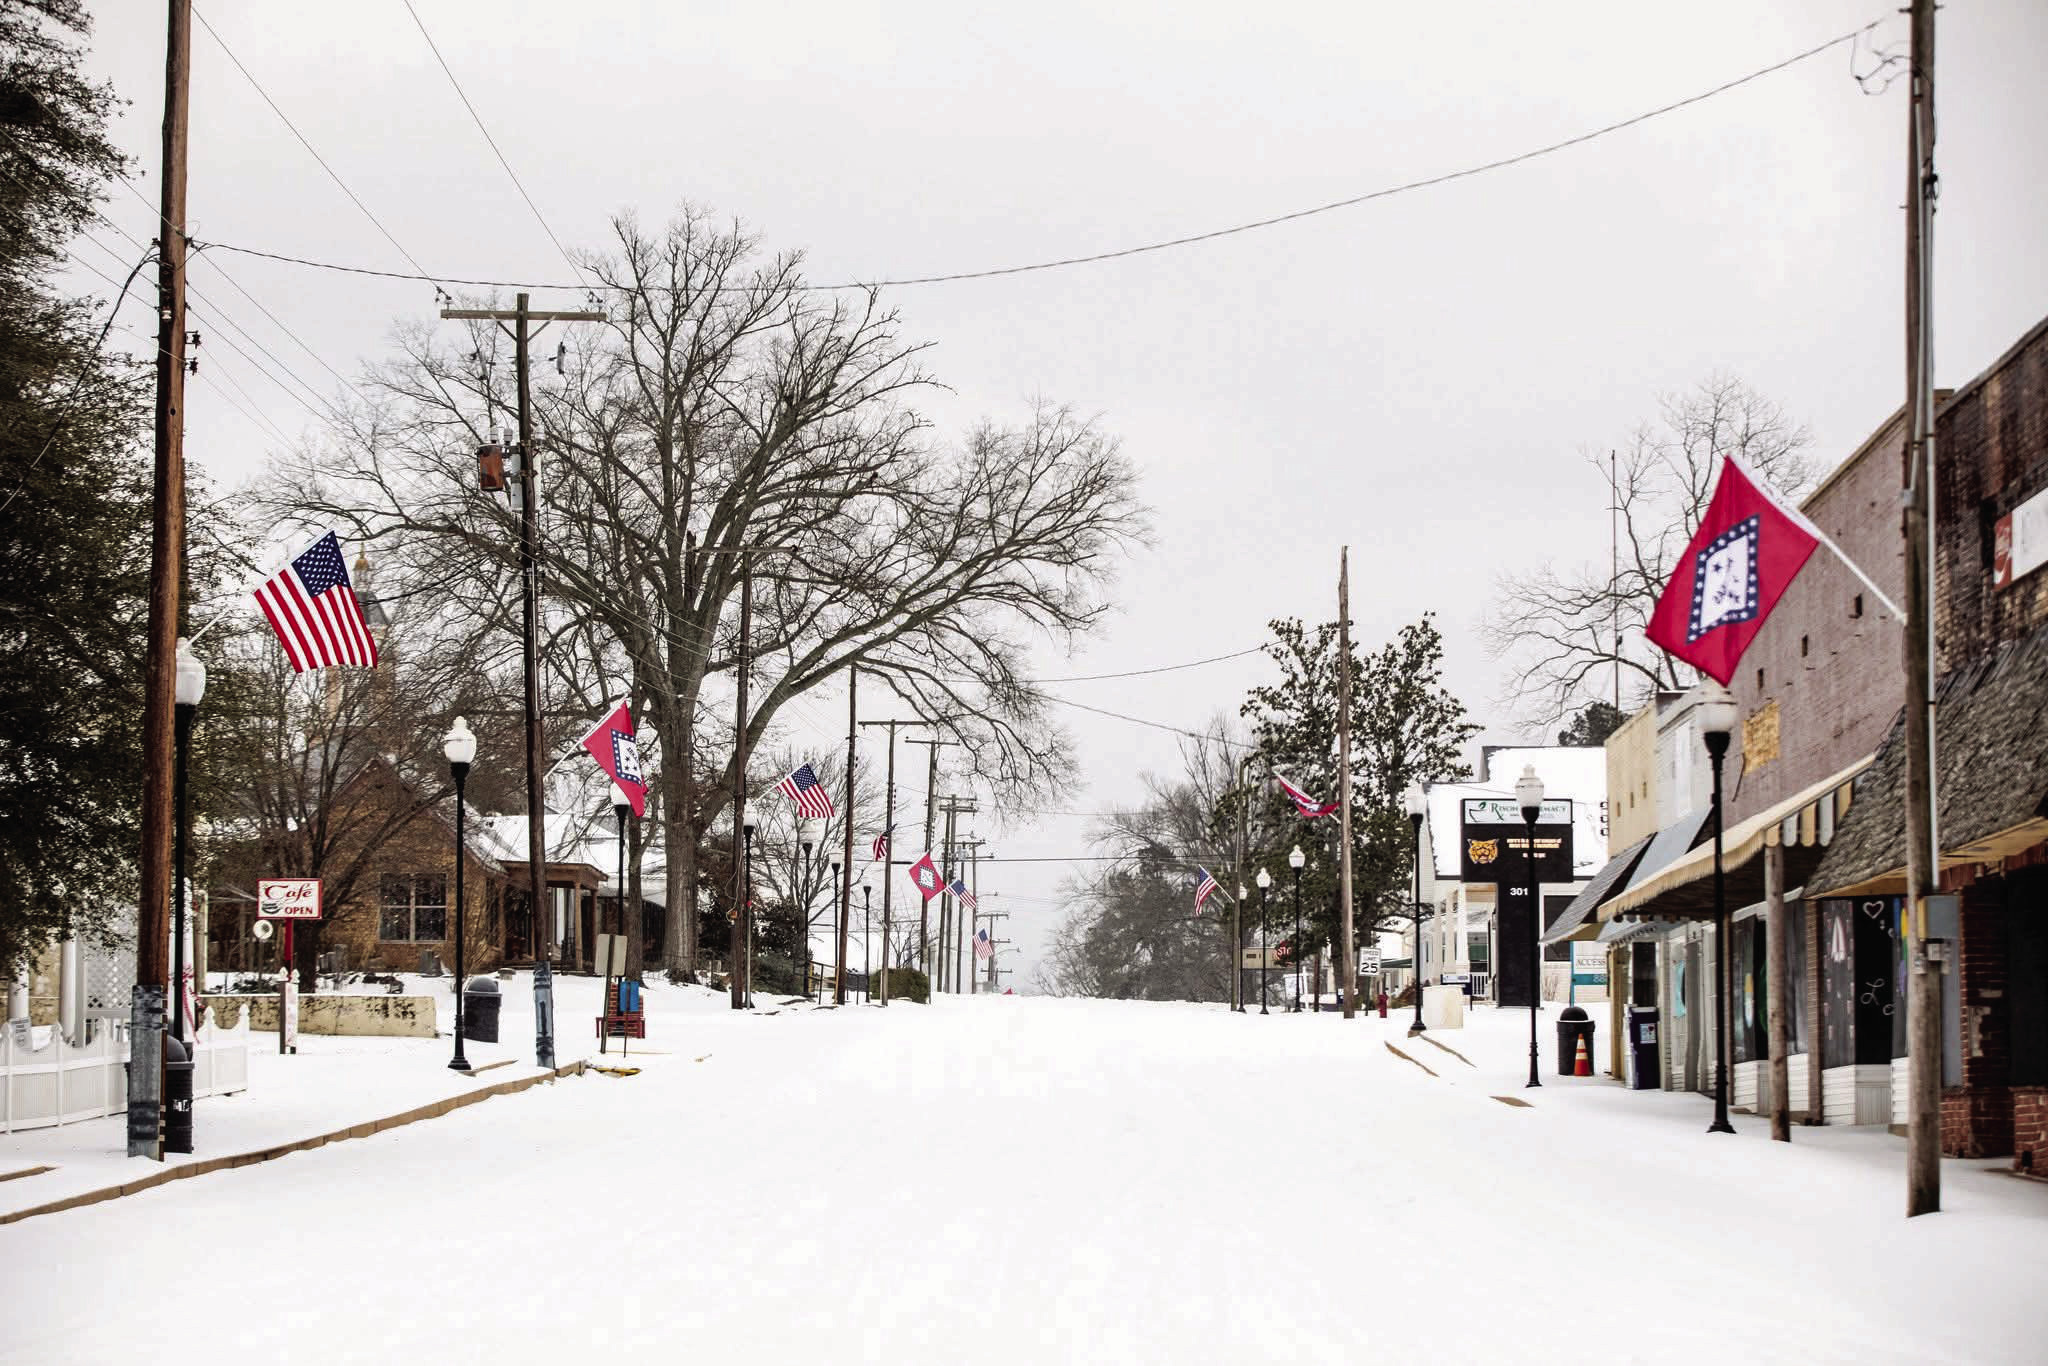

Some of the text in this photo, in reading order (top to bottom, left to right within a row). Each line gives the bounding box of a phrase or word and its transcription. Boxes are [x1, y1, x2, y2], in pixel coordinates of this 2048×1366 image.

[264, 883, 313, 902] Café
[1510, 888, 1528, 896] 301
[285, 906, 313, 914] OPEN
[1361, 962, 1378, 973] 25
